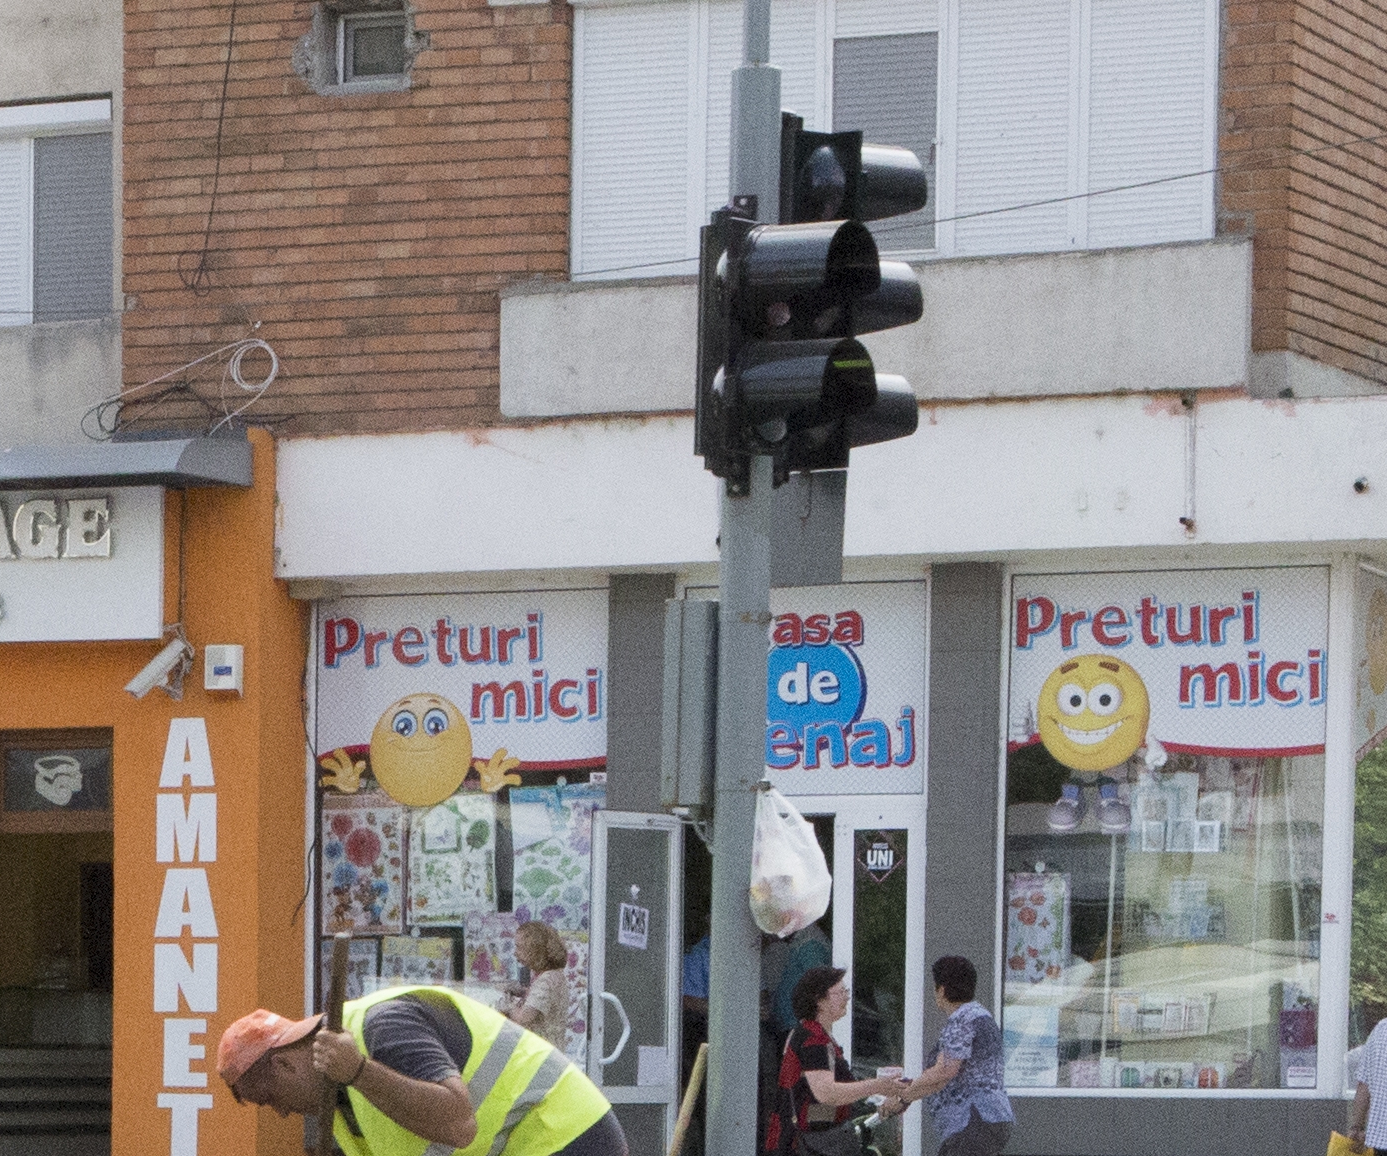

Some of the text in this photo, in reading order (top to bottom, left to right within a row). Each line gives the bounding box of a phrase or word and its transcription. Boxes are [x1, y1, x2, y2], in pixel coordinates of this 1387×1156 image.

[324, 612, 544, 668] Preturi
[769, 607, 865, 647] asa
[1015, 591, 1260, 649] Preturi
[469, 667, 603, 723] mici
[777, 661, 839, 705] de
[1177, 649, 1325, 708] mici
[766, 707, 916, 770] enaj
[866, 849, 894, 866] UNI
